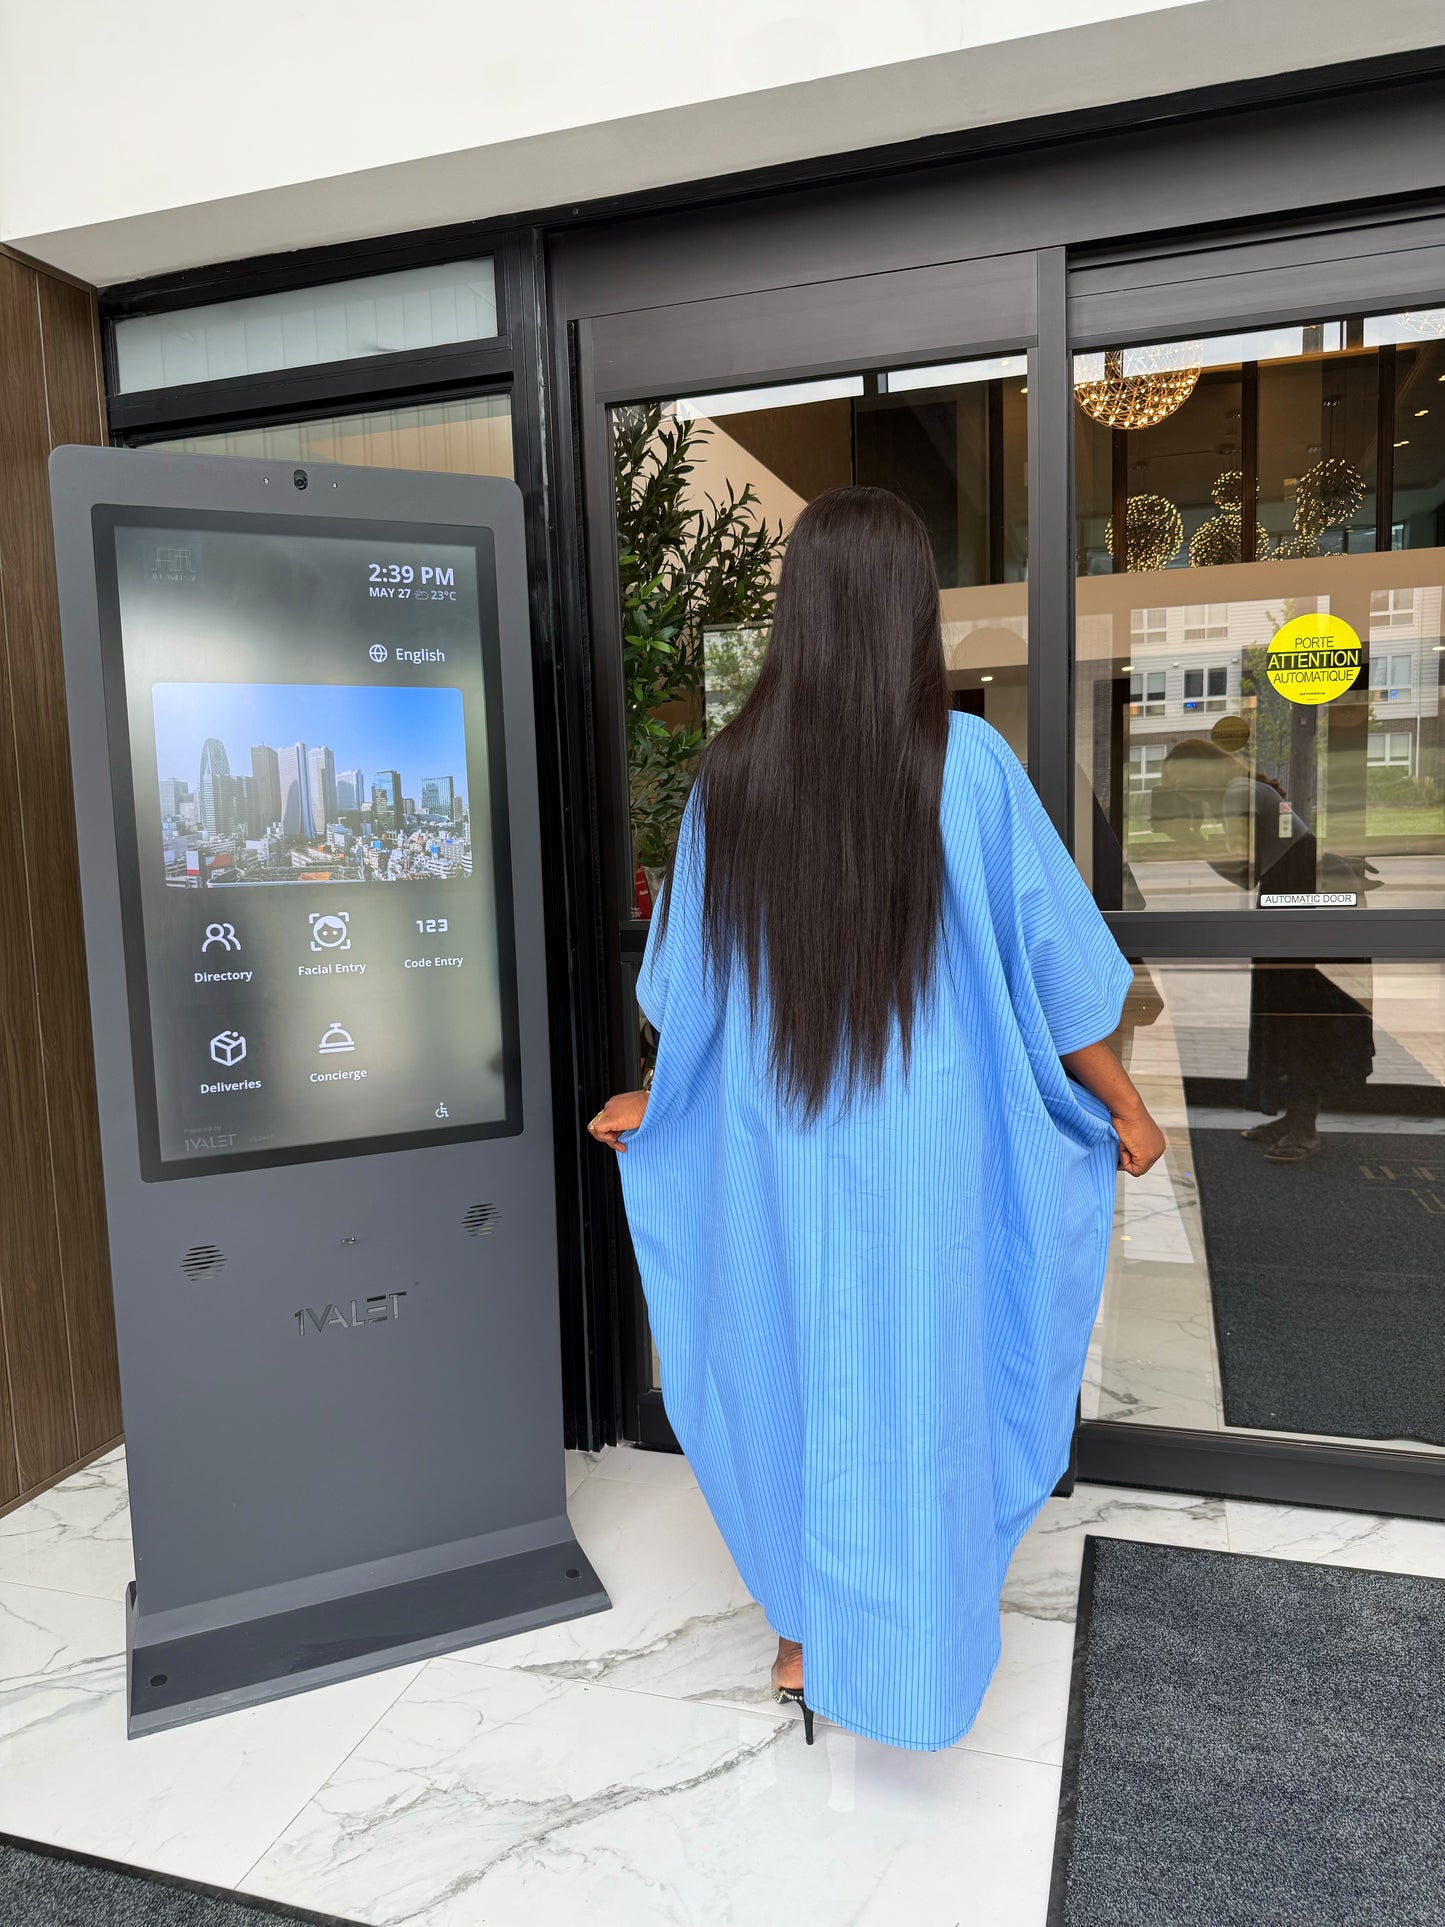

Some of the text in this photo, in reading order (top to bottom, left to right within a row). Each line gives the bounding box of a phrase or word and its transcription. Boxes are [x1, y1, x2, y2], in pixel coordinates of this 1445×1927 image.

[368, 563, 455, 586] 2:39 PM
[369, 587, 456, 601] MAY 27 23°C
[1295, 636, 1335, 649] PORTE
[396, 648, 445, 664] English
[1268, 650, 1359, 669] ATTENTION
[1273, 670, 1354, 684] AUTOMATIQUE
[1264, 894, 1352, 904] AUTOMATIC DOOR
[416, 918, 449, 934] 123
[298, 963, 367, 976] Facial Entry
[404, 956, 464, 969] Code Entry
[194, 970, 253, 983] Directory
[309, 1068, 368, 1083] Concierge
[200, 1079, 262, 1095] Deliveries
[184, 1133, 238, 1152] 1VALET
[294, 1291, 408, 1336] 1VALET
